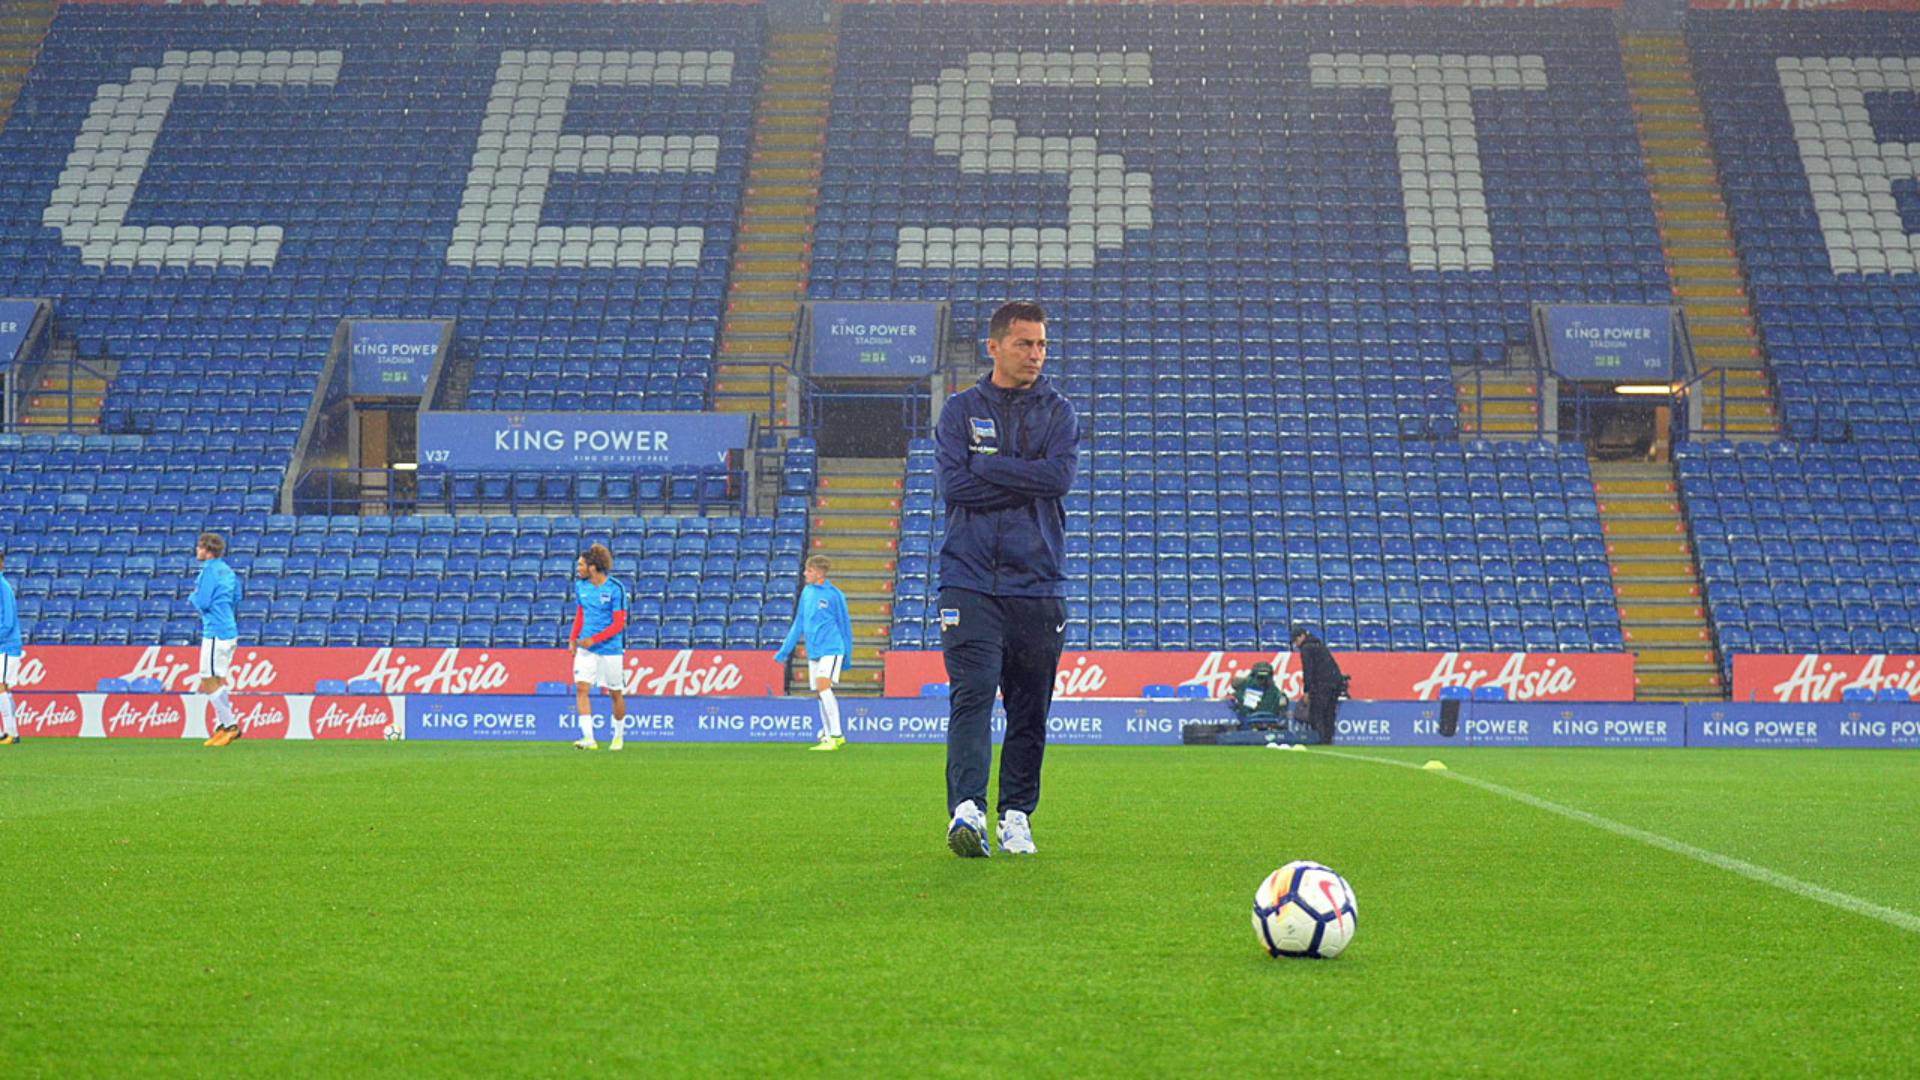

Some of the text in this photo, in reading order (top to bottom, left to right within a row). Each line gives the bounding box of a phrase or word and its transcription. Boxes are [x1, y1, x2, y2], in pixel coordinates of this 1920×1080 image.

[831, 325, 917, 336] KING POWER
[1565, 328, 1651, 339] KING POWER
[353, 344, 388, 355] KING
[495, 430, 669, 451] KING POWER
[425, 450, 450, 462] V37
[422, 713, 536, 728] KING POWER
[698, 715, 812, 730] KING POWER
[847, 717, 949, 731] KING POWE
[1126, 718, 1173, 733] KING
[1335, 719, 1390, 734] OWER
[1464, 720, 1528, 734] POWER
[1553, 720, 1667, 735] KING POWER
[1703, 721, 1817, 736] KING POWER
[1840, 721, 1886, 735] KING
